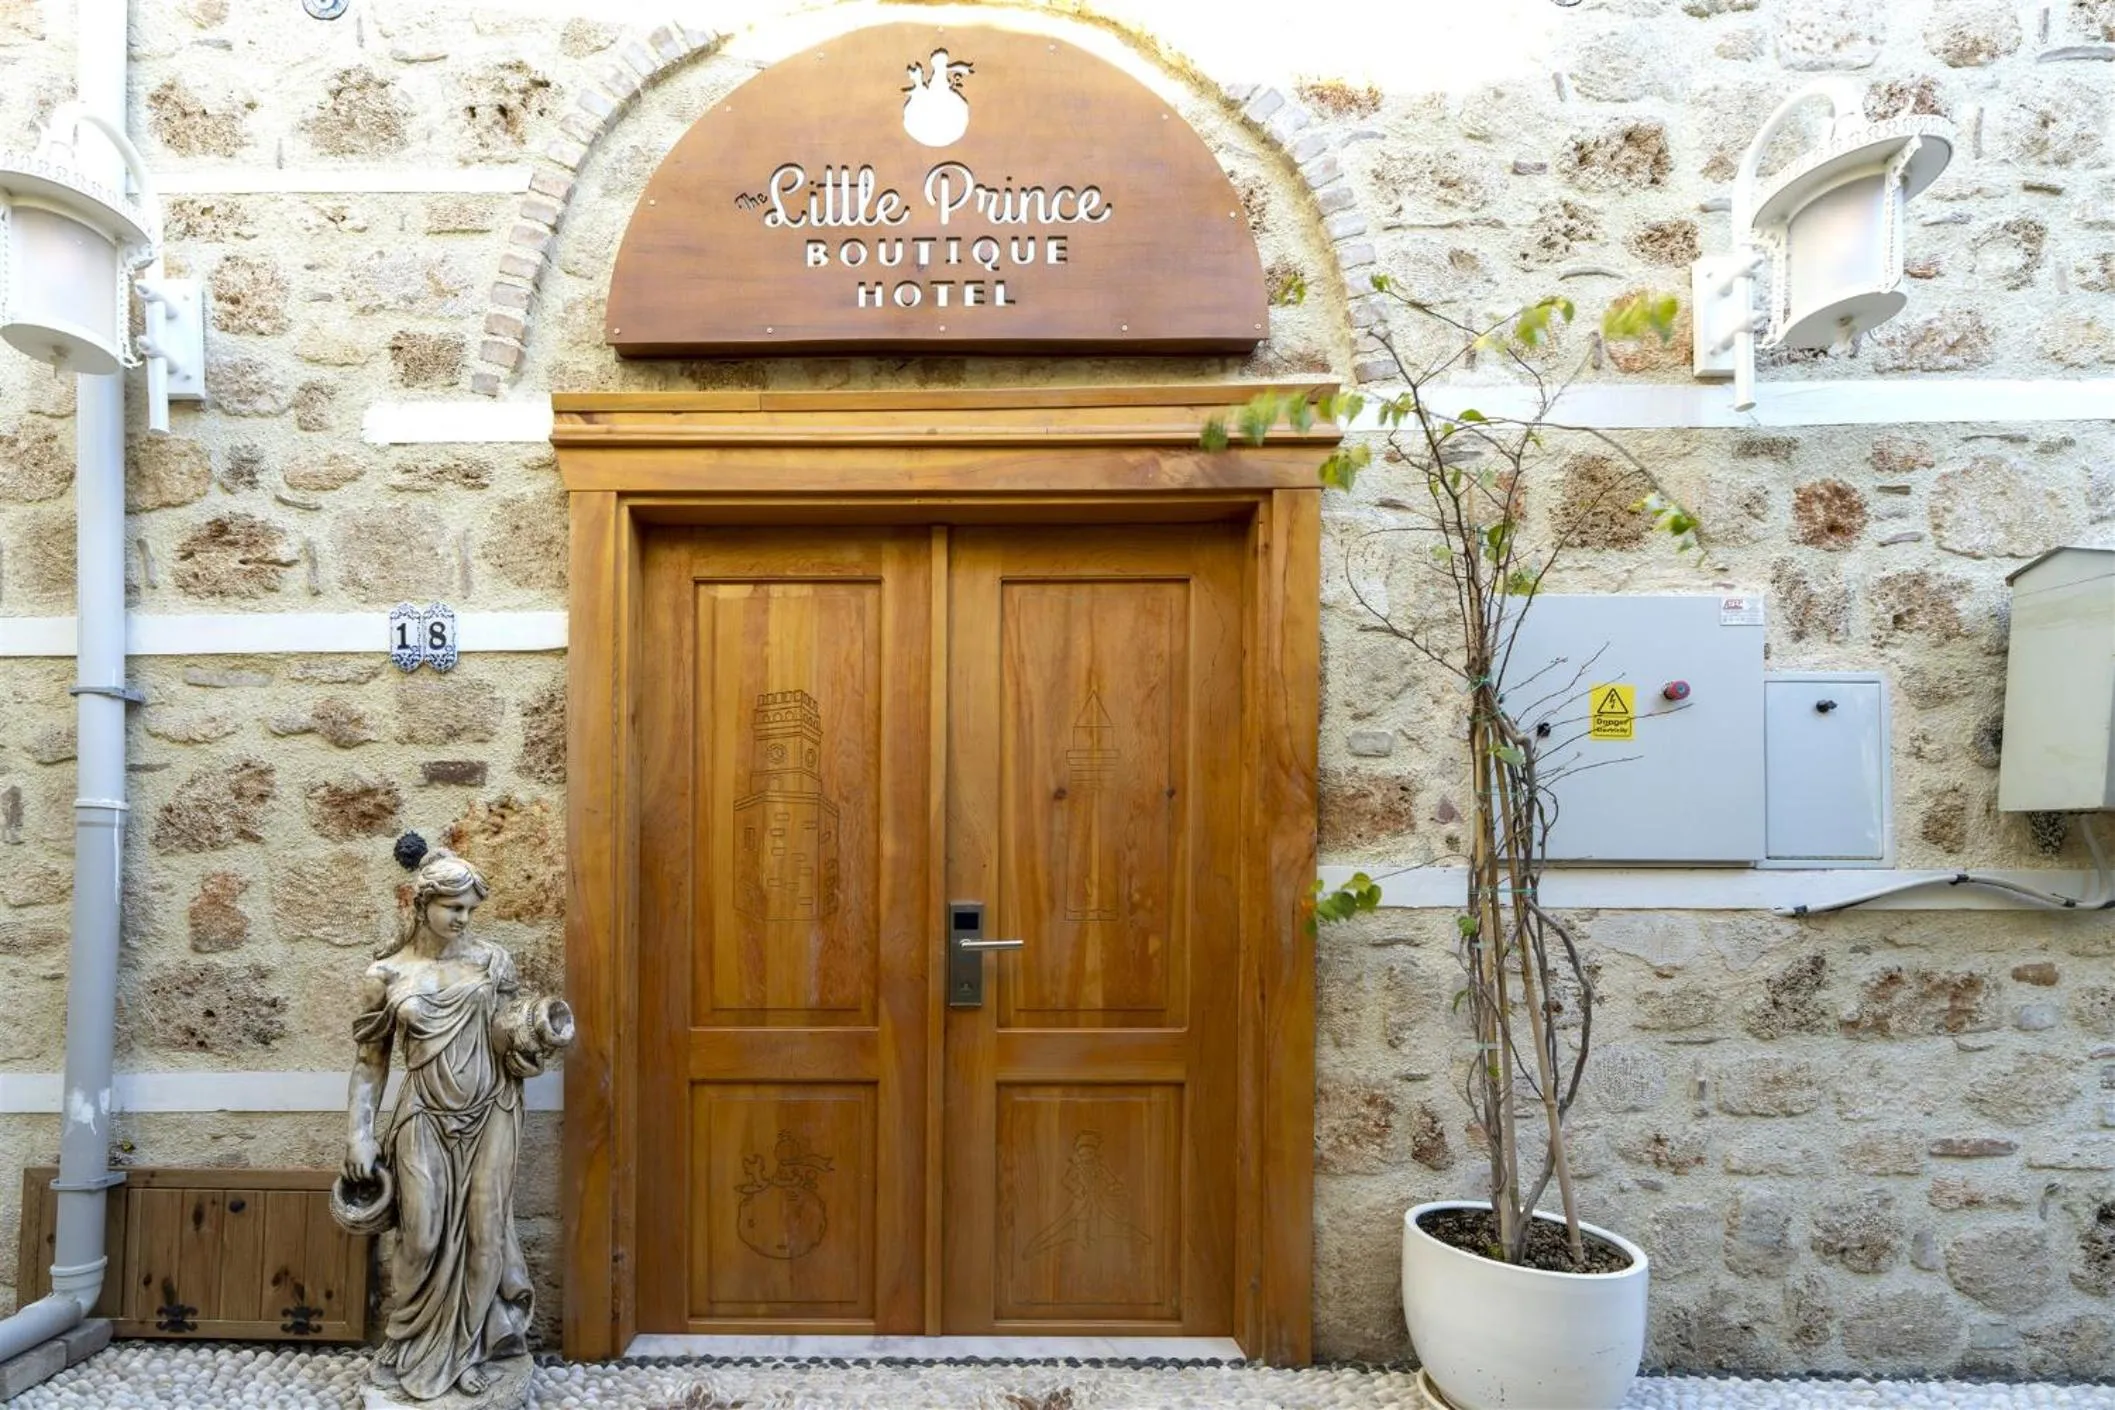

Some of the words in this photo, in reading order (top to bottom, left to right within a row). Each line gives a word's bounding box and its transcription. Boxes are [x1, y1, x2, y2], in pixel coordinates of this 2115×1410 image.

[734, 191, 768, 211] The
[764, 163, 910, 228] Little
[924, 161, 1112, 225] Prince
[806, 236, 1068, 271] BOUTIQUE
[857, 280, 1016, 308] HOTEL
